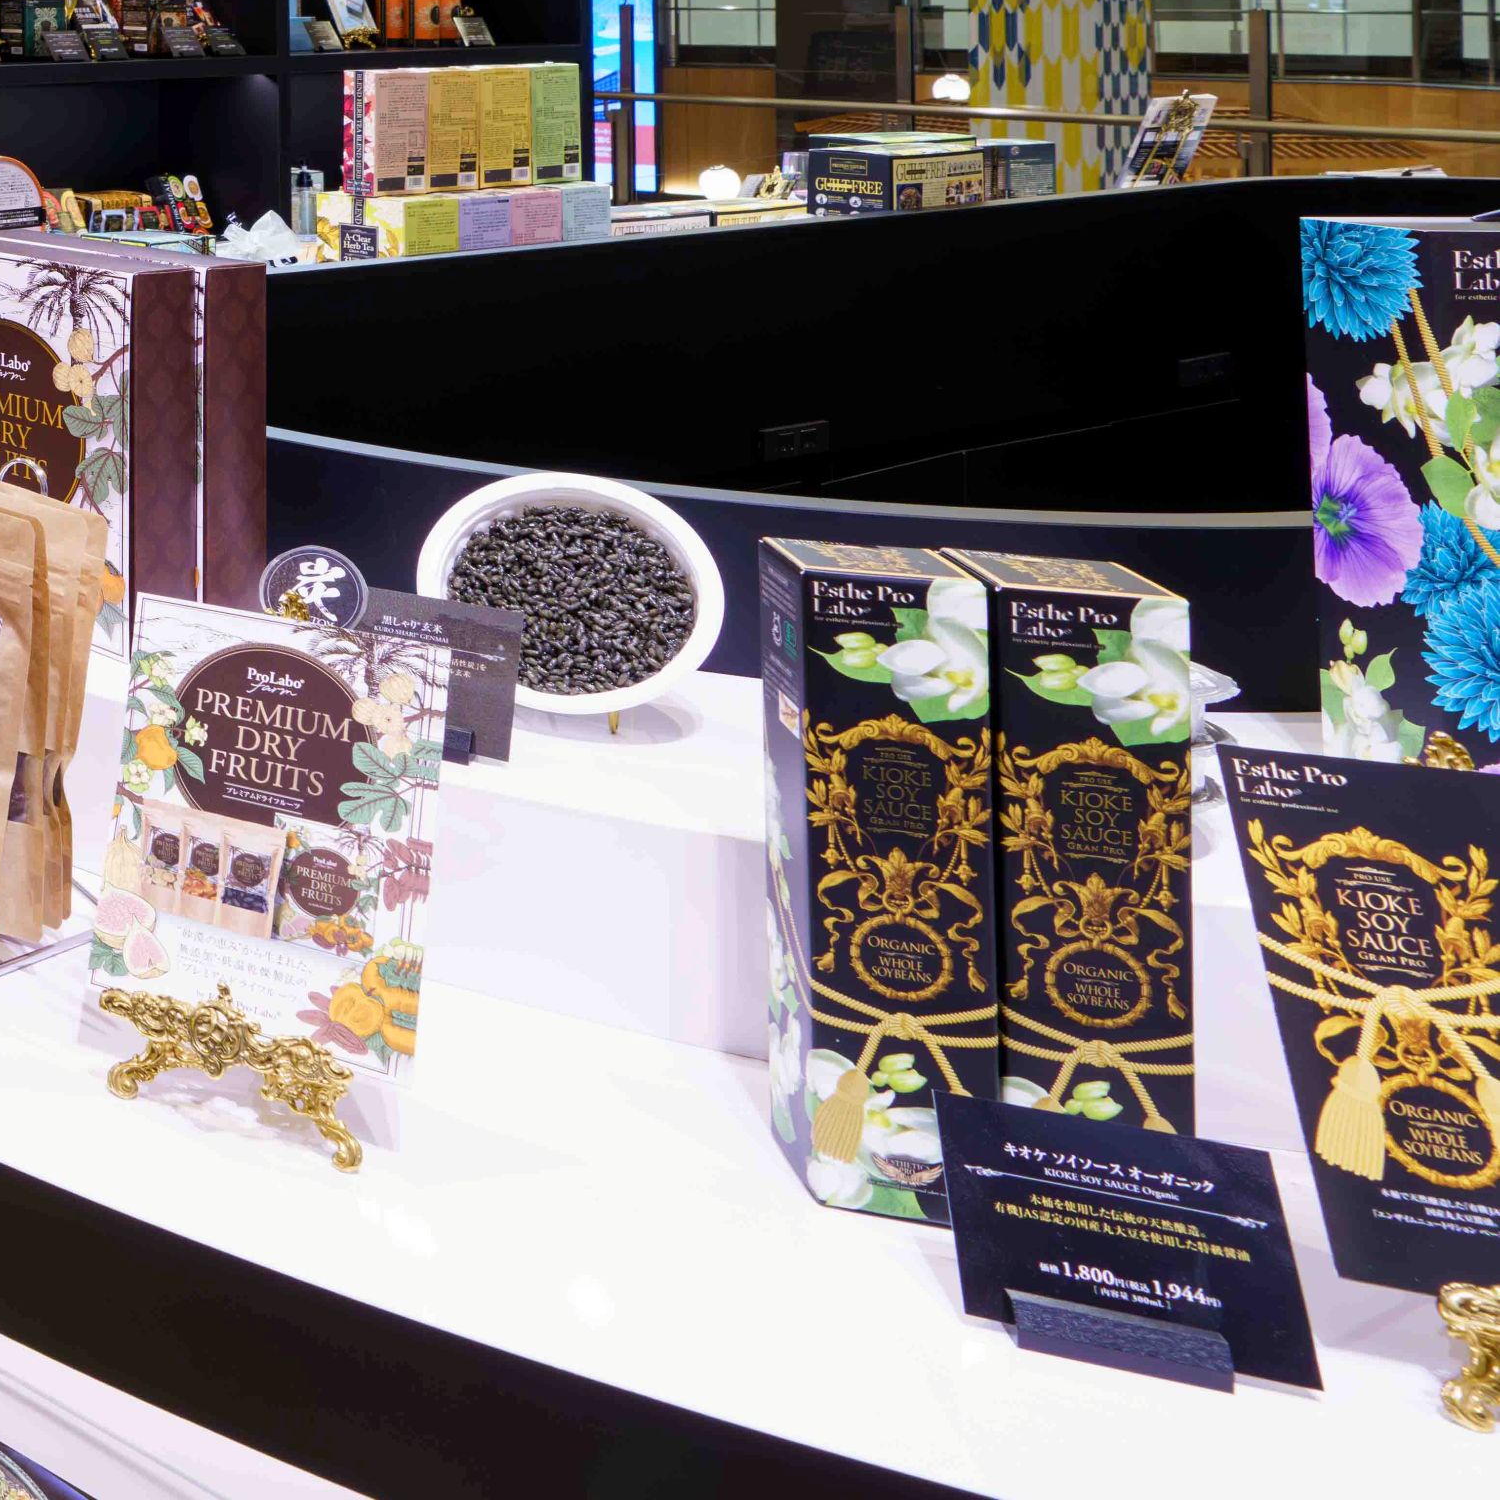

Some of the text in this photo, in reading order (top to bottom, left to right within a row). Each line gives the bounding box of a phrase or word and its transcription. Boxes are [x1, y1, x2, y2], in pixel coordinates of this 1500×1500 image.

[851, 181, 883, 195] FREE
[343, 241, 375, 252] Herb Tea
[344, 234, 371, 244] A-Clear
[813, 580, 915, 604] Esthe Pro
[1011, 600, 1118, 625] Esthe Pro
[373, 625, 449, 644] KURO GENMAI
[246, 680, 297, 697] farm
[195, 688, 353, 743] PREMIUM
[235, 725, 307, 761] DRY
[208, 748, 325, 797] FRUITS
[862, 765, 933, 787] KIOKE
[1231, 757, 1348, 787] Esthe Pro
[226, 786, 301, 811] プレミアムドライフルーツ
[875, 782, 921, 803] SOY
[1061, 789, 1134, 813] KIOKE
[864, 799, 933, 821] SAUCE
[1252, 798, 1279, 807] esthetic
[1281, 802, 1325, 813] professional
[869, 815, 902, 828] GRAN
[1073, 808, 1121, 828] SOY
[1061, 824, 1134, 847] SAUCE
[1066, 841, 1100, 854] GRAN
[296, 865, 351, 888] PREMIUM
[311, 879, 335, 894] DRY
[1353, 873, 1393, 884] PRO USE
[301, 887, 342, 906] FRUITS
[1336, 888, 1424, 917] KIOKE
[1356, 910, 1411, 935] SOY
[867, 935, 936, 956] ORGANIC
[1346, 929, 1434, 958] SAUCE
[879, 955, 924, 972] WHOLE
[1358, 950, 1396, 965] GRAN
[871, 965, 933, 984] SOYBEANS
[1063, 961, 1134, 983] ORGANIC
[1066, 991, 1130, 1012] SOYBEANS
[1075, 982, 1122, 999] WHOLE
[1389, 1100, 1479, 1129] ORGANIC
[1408, 1127, 1469, 1150] WHOLE
[1402, 1140, 1483, 1166] SOYBEANS
[1003, 1141, 1215, 1194] キオケ ソイソース オーガニック
[1044, 1167, 1180, 1202] KIOKE SOY SAUCE Organic
